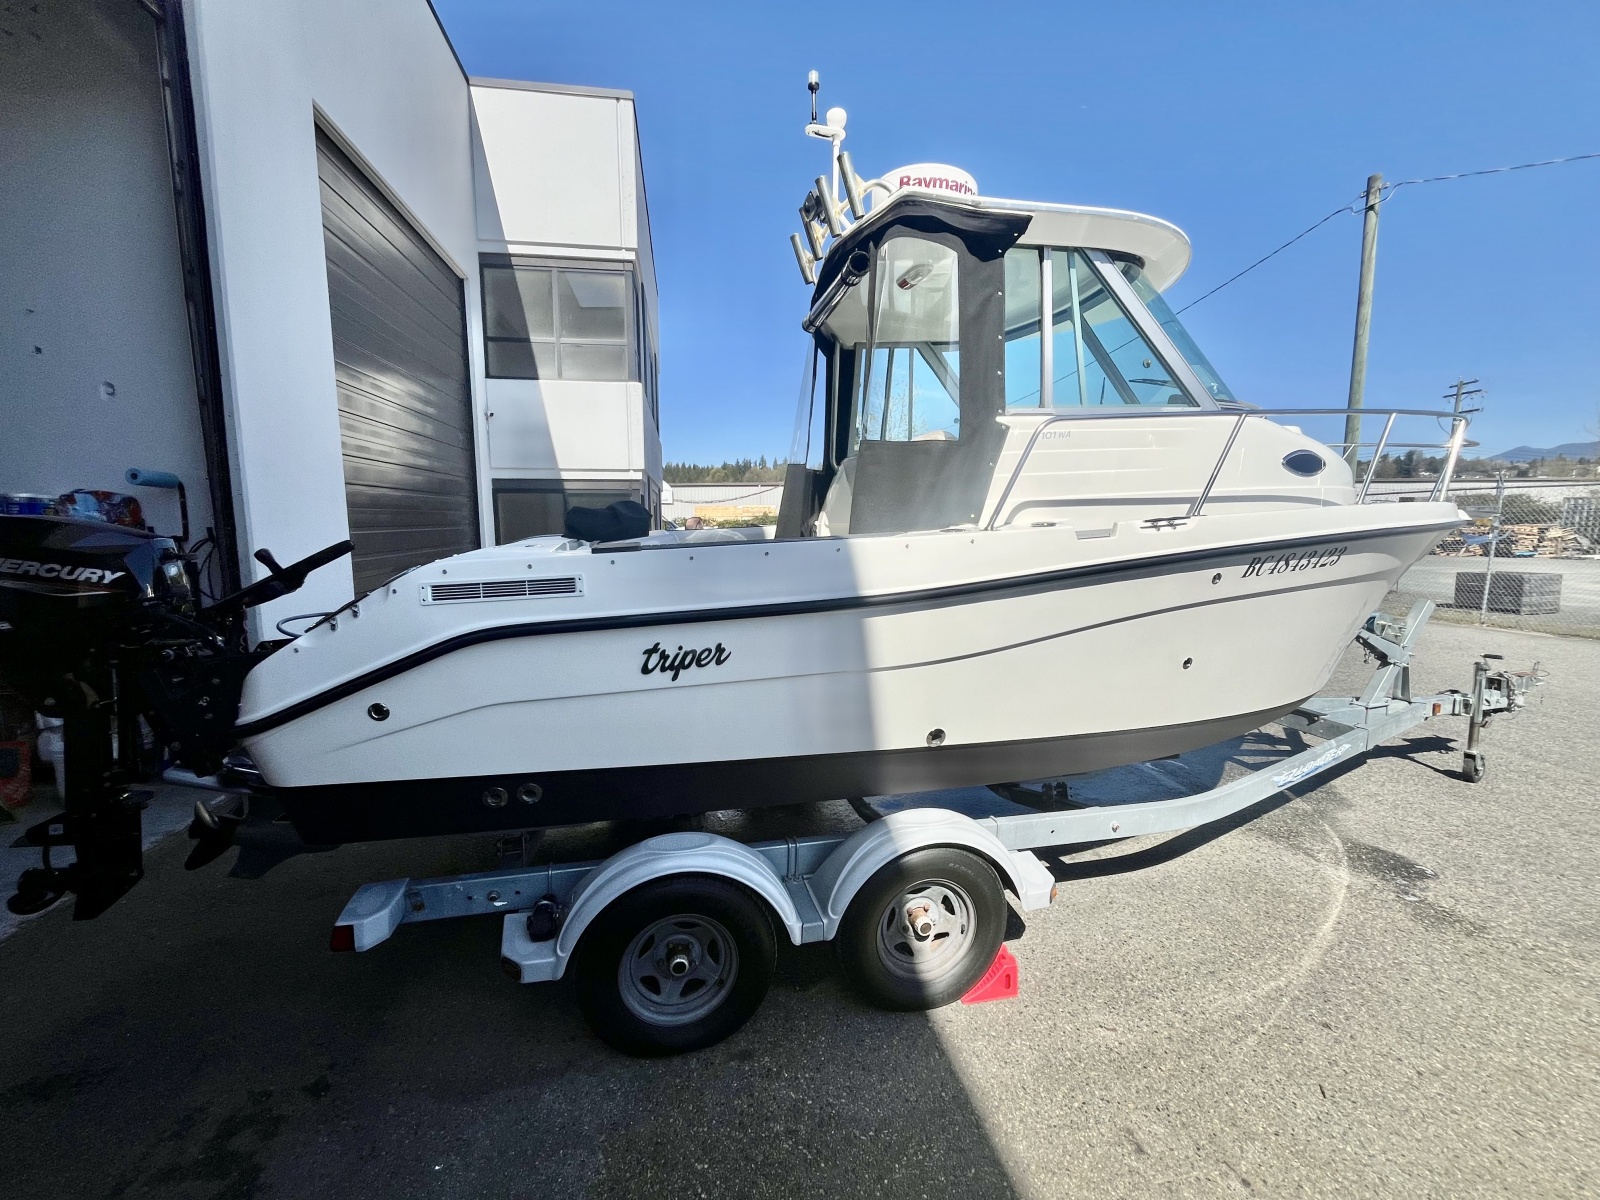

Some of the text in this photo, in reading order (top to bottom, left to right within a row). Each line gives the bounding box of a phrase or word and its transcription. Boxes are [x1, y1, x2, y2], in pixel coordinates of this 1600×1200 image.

[899, 175, 976, 195] Raymarin
[1058, 430, 1071, 439] WA
[0, 557, 126, 584] ERCURY
[641, 642, 732, 682] triper
